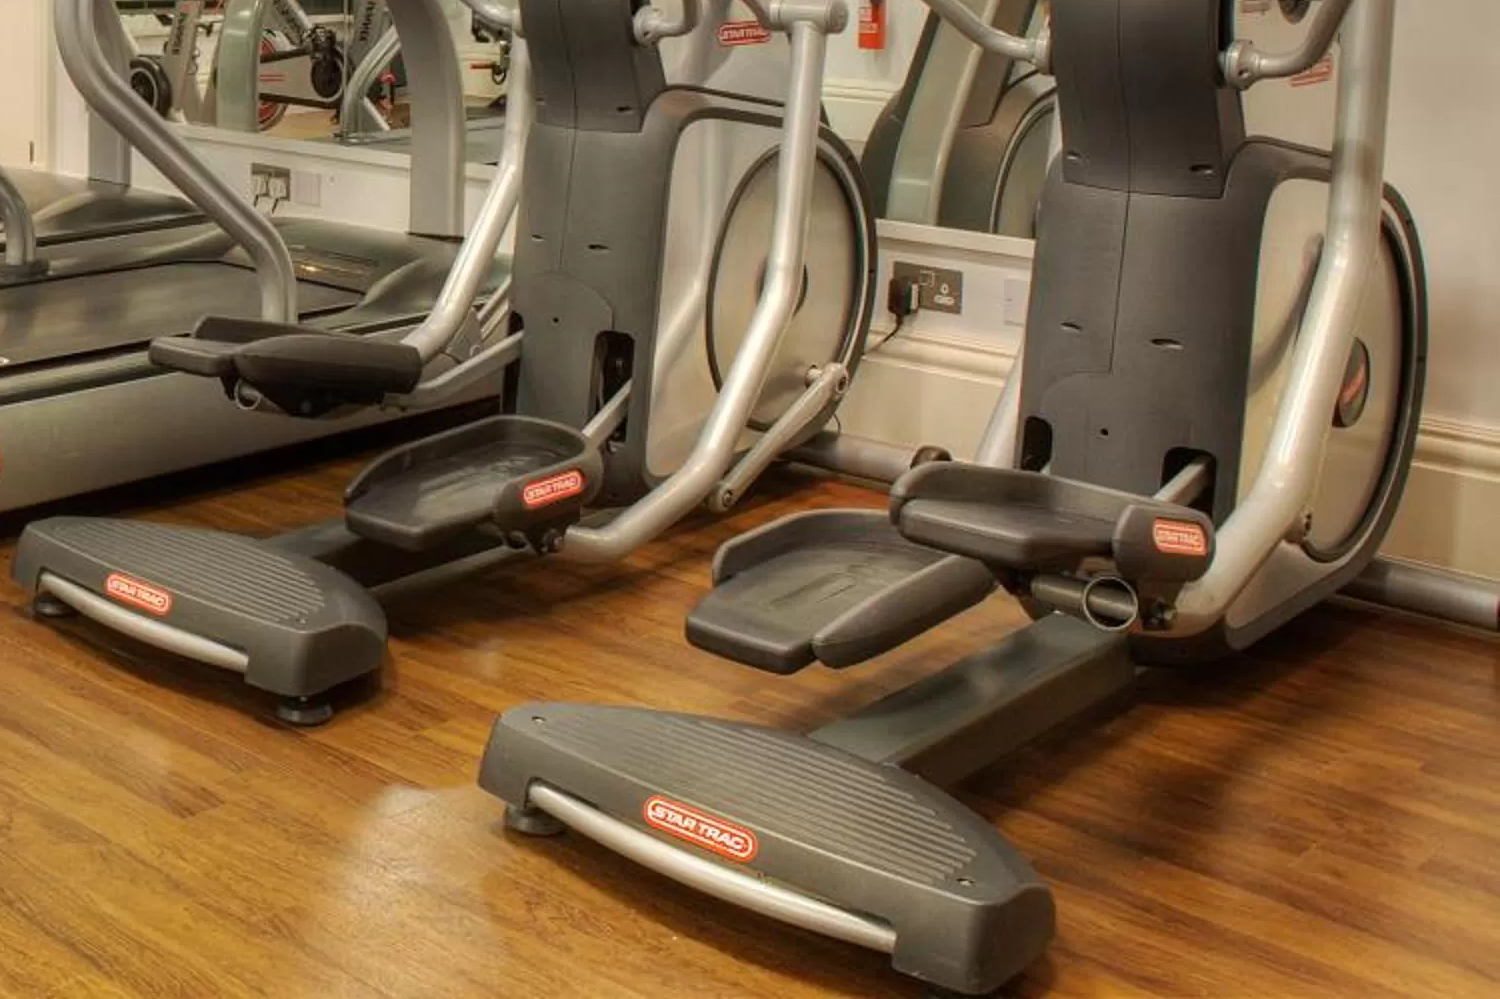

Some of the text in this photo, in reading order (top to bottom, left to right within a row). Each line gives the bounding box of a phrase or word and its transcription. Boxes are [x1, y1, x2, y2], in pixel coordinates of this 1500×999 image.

[526, 476, 579, 500] STAR TRAC
[109, 580, 165, 607] STAR TRAC
[650, 804, 746, 851] STAR TRAC
